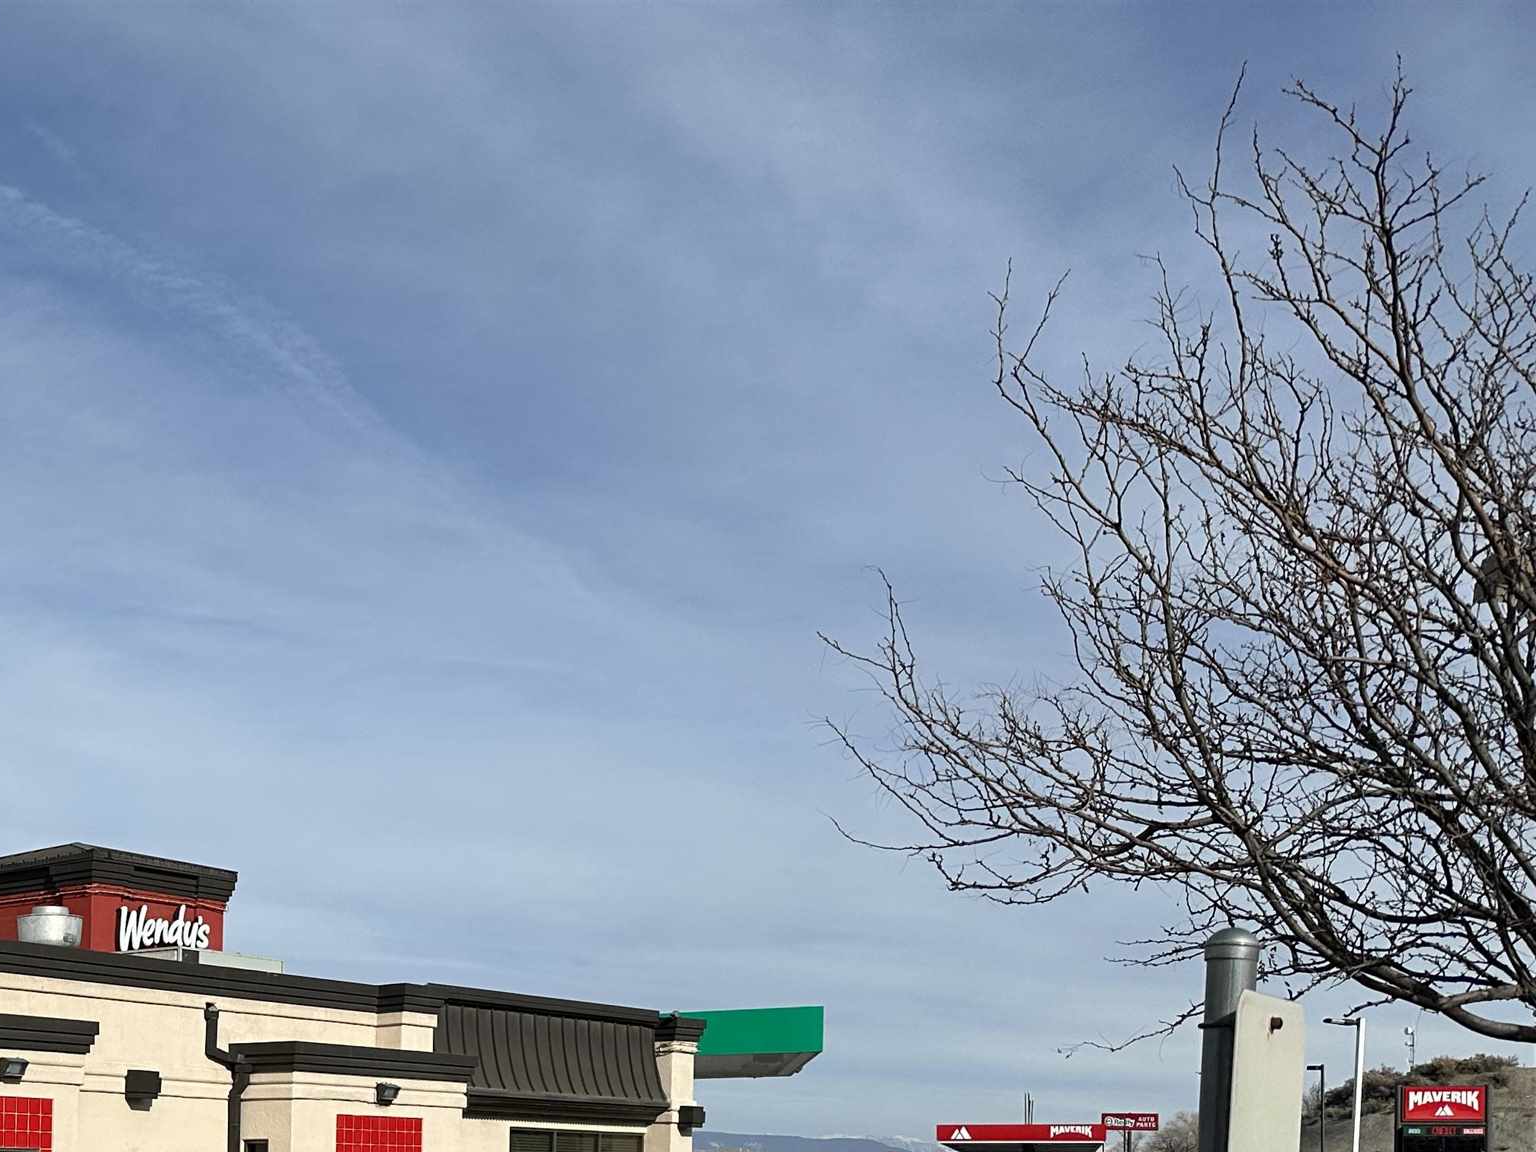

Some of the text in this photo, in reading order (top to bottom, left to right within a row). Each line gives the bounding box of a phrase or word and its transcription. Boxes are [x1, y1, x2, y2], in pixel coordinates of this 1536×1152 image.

[120, 905, 211, 951] Wendy's
[1408, 1091, 1480, 1112] MAVERIK
[1050, 1125, 1093, 1138] MAVERIK
